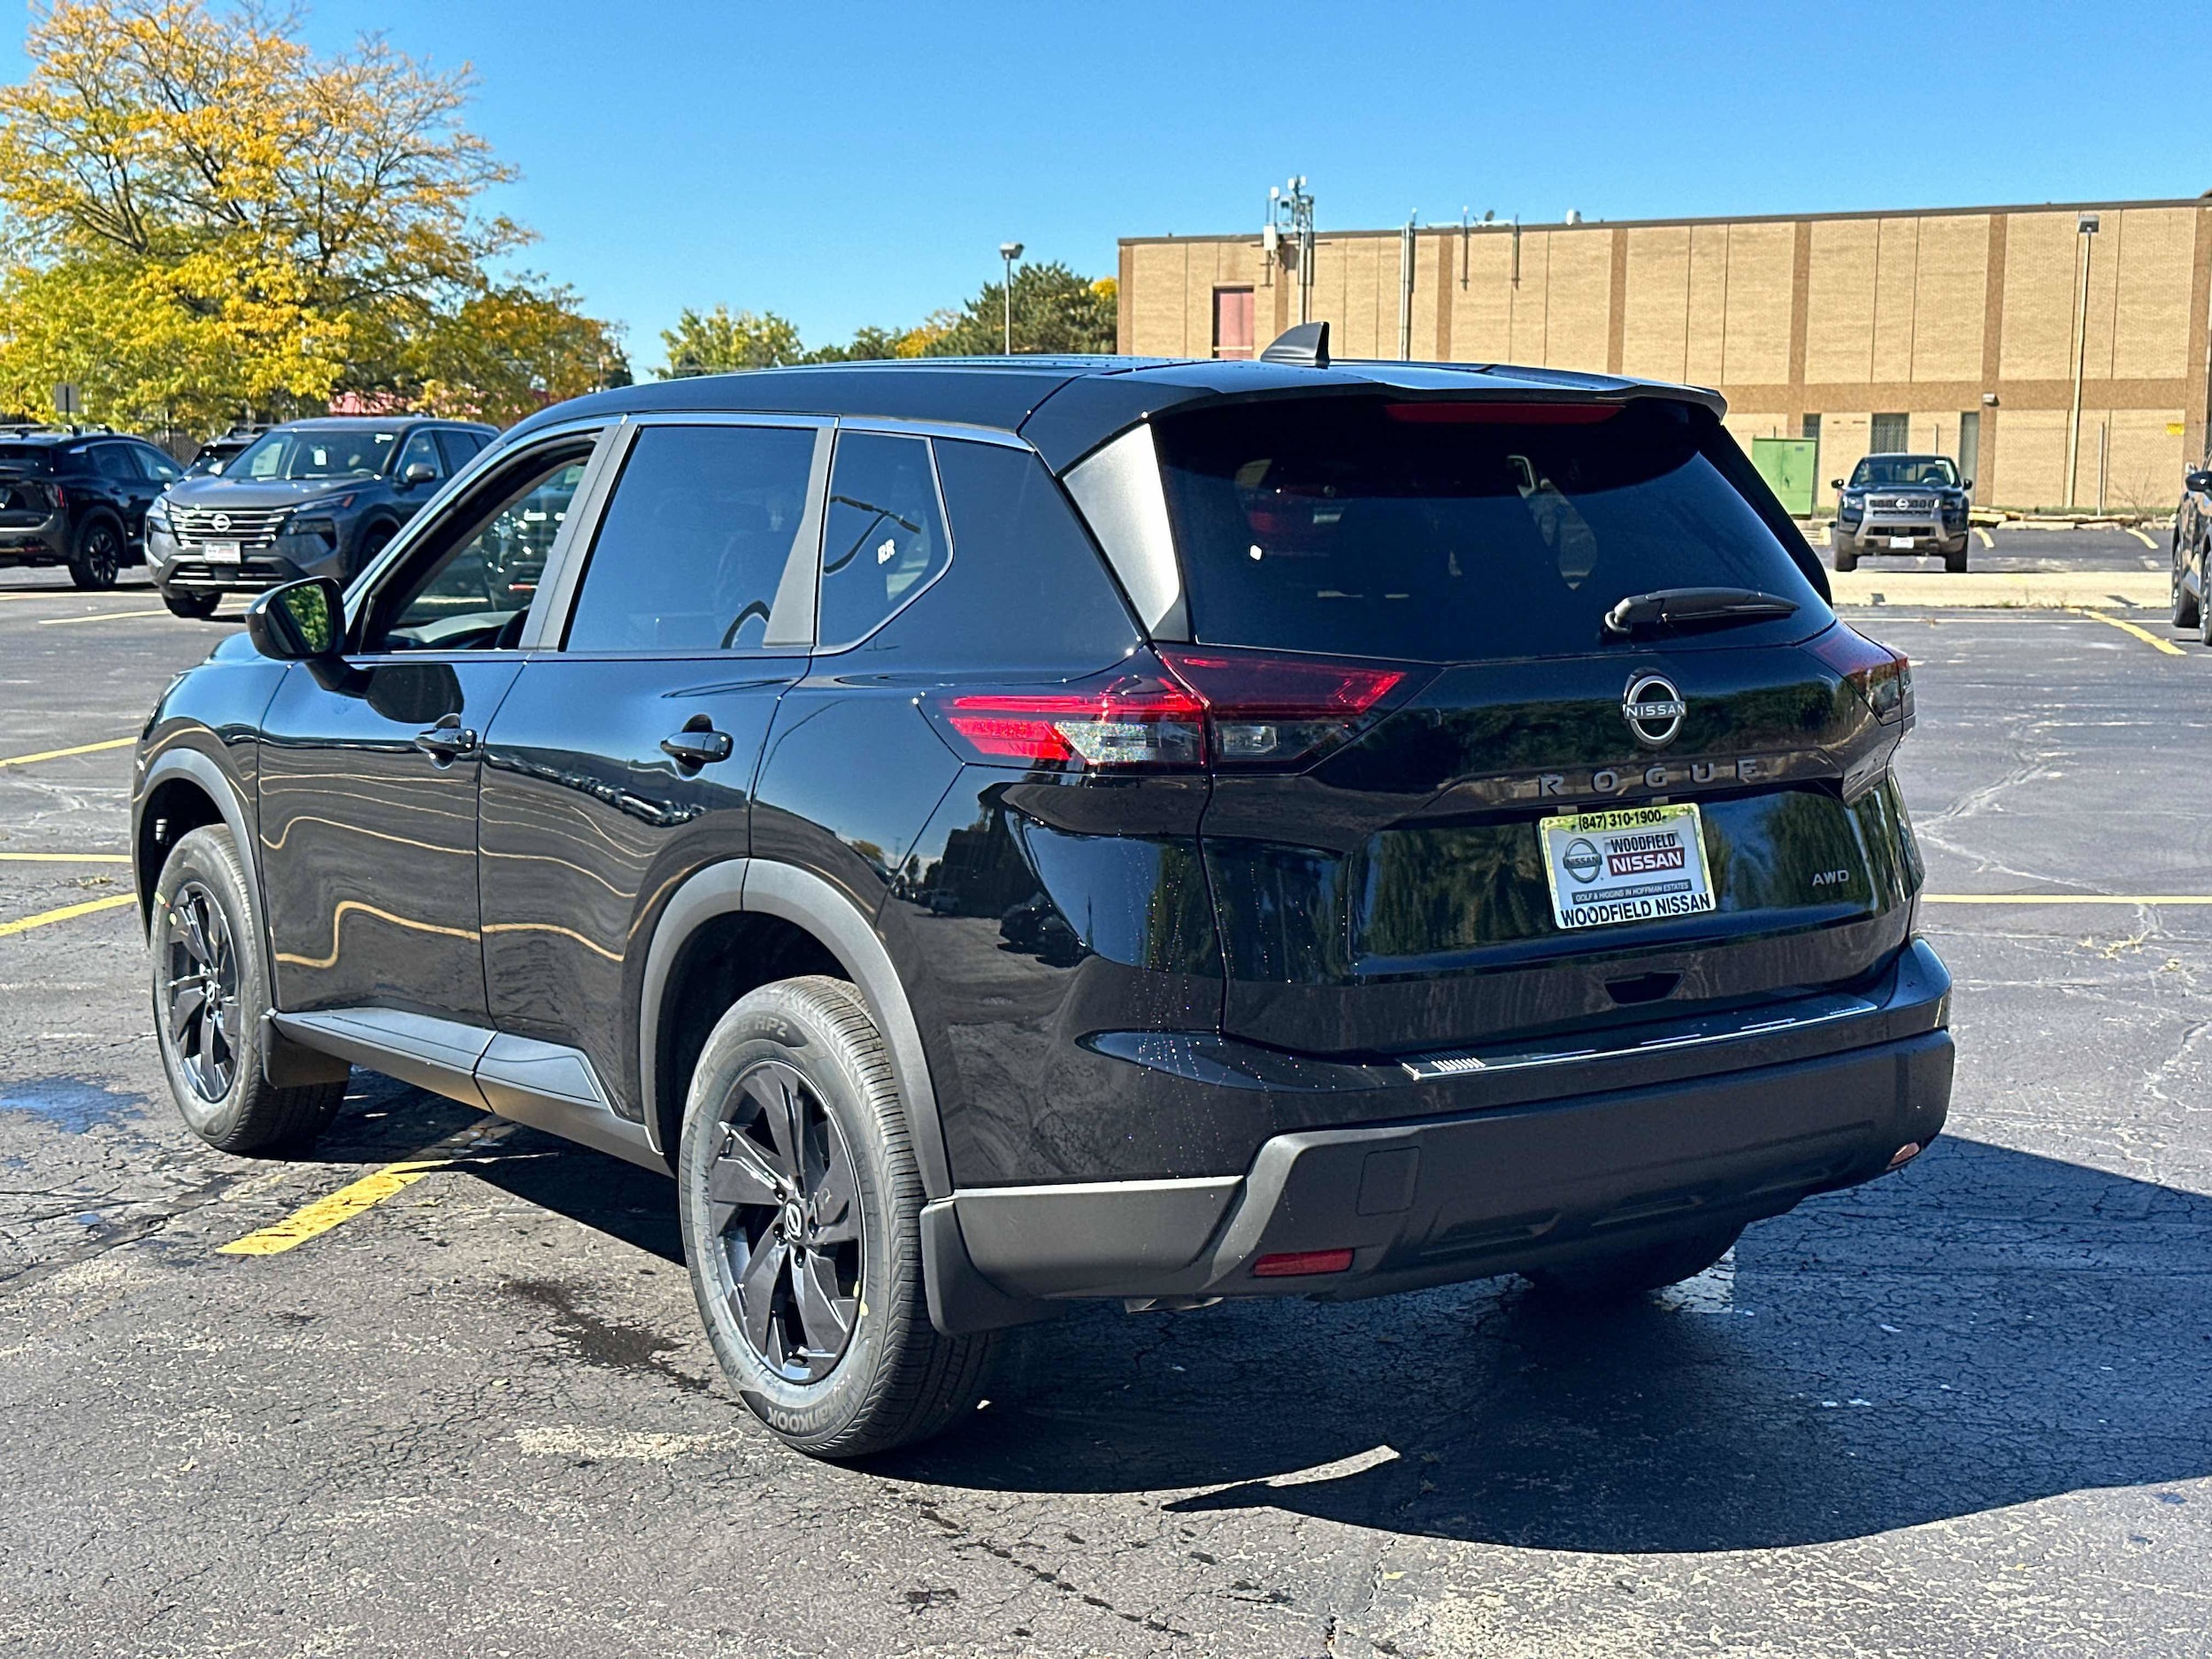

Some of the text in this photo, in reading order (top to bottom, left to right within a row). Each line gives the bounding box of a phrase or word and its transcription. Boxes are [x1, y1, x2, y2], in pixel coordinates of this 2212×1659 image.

[1626, 704, 1686, 717] NISSAN
[1538, 758, 1757, 796] ROGUE
[1578, 810, 1662, 832] (847) 310-1900
[1610, 833, 1676, 853] WOODFIELD
[1566, 856, 1599, 866] NISSAN
[1611, 851, 1683, 872] NISSAN
[1812, 870, 1849, 887] AWD
[1575, 892, 1593, 902] GOLF
[1599, 888, 1624, 899] HIGGINS
[1625, 887, 1632, 896] IN
[1632, 885, 1663, 895] HOFFMAN
[1663, 881, 1689, 892] ESTATES
[1561, 893, 1711, 926] WOODFIELD NISSAN
